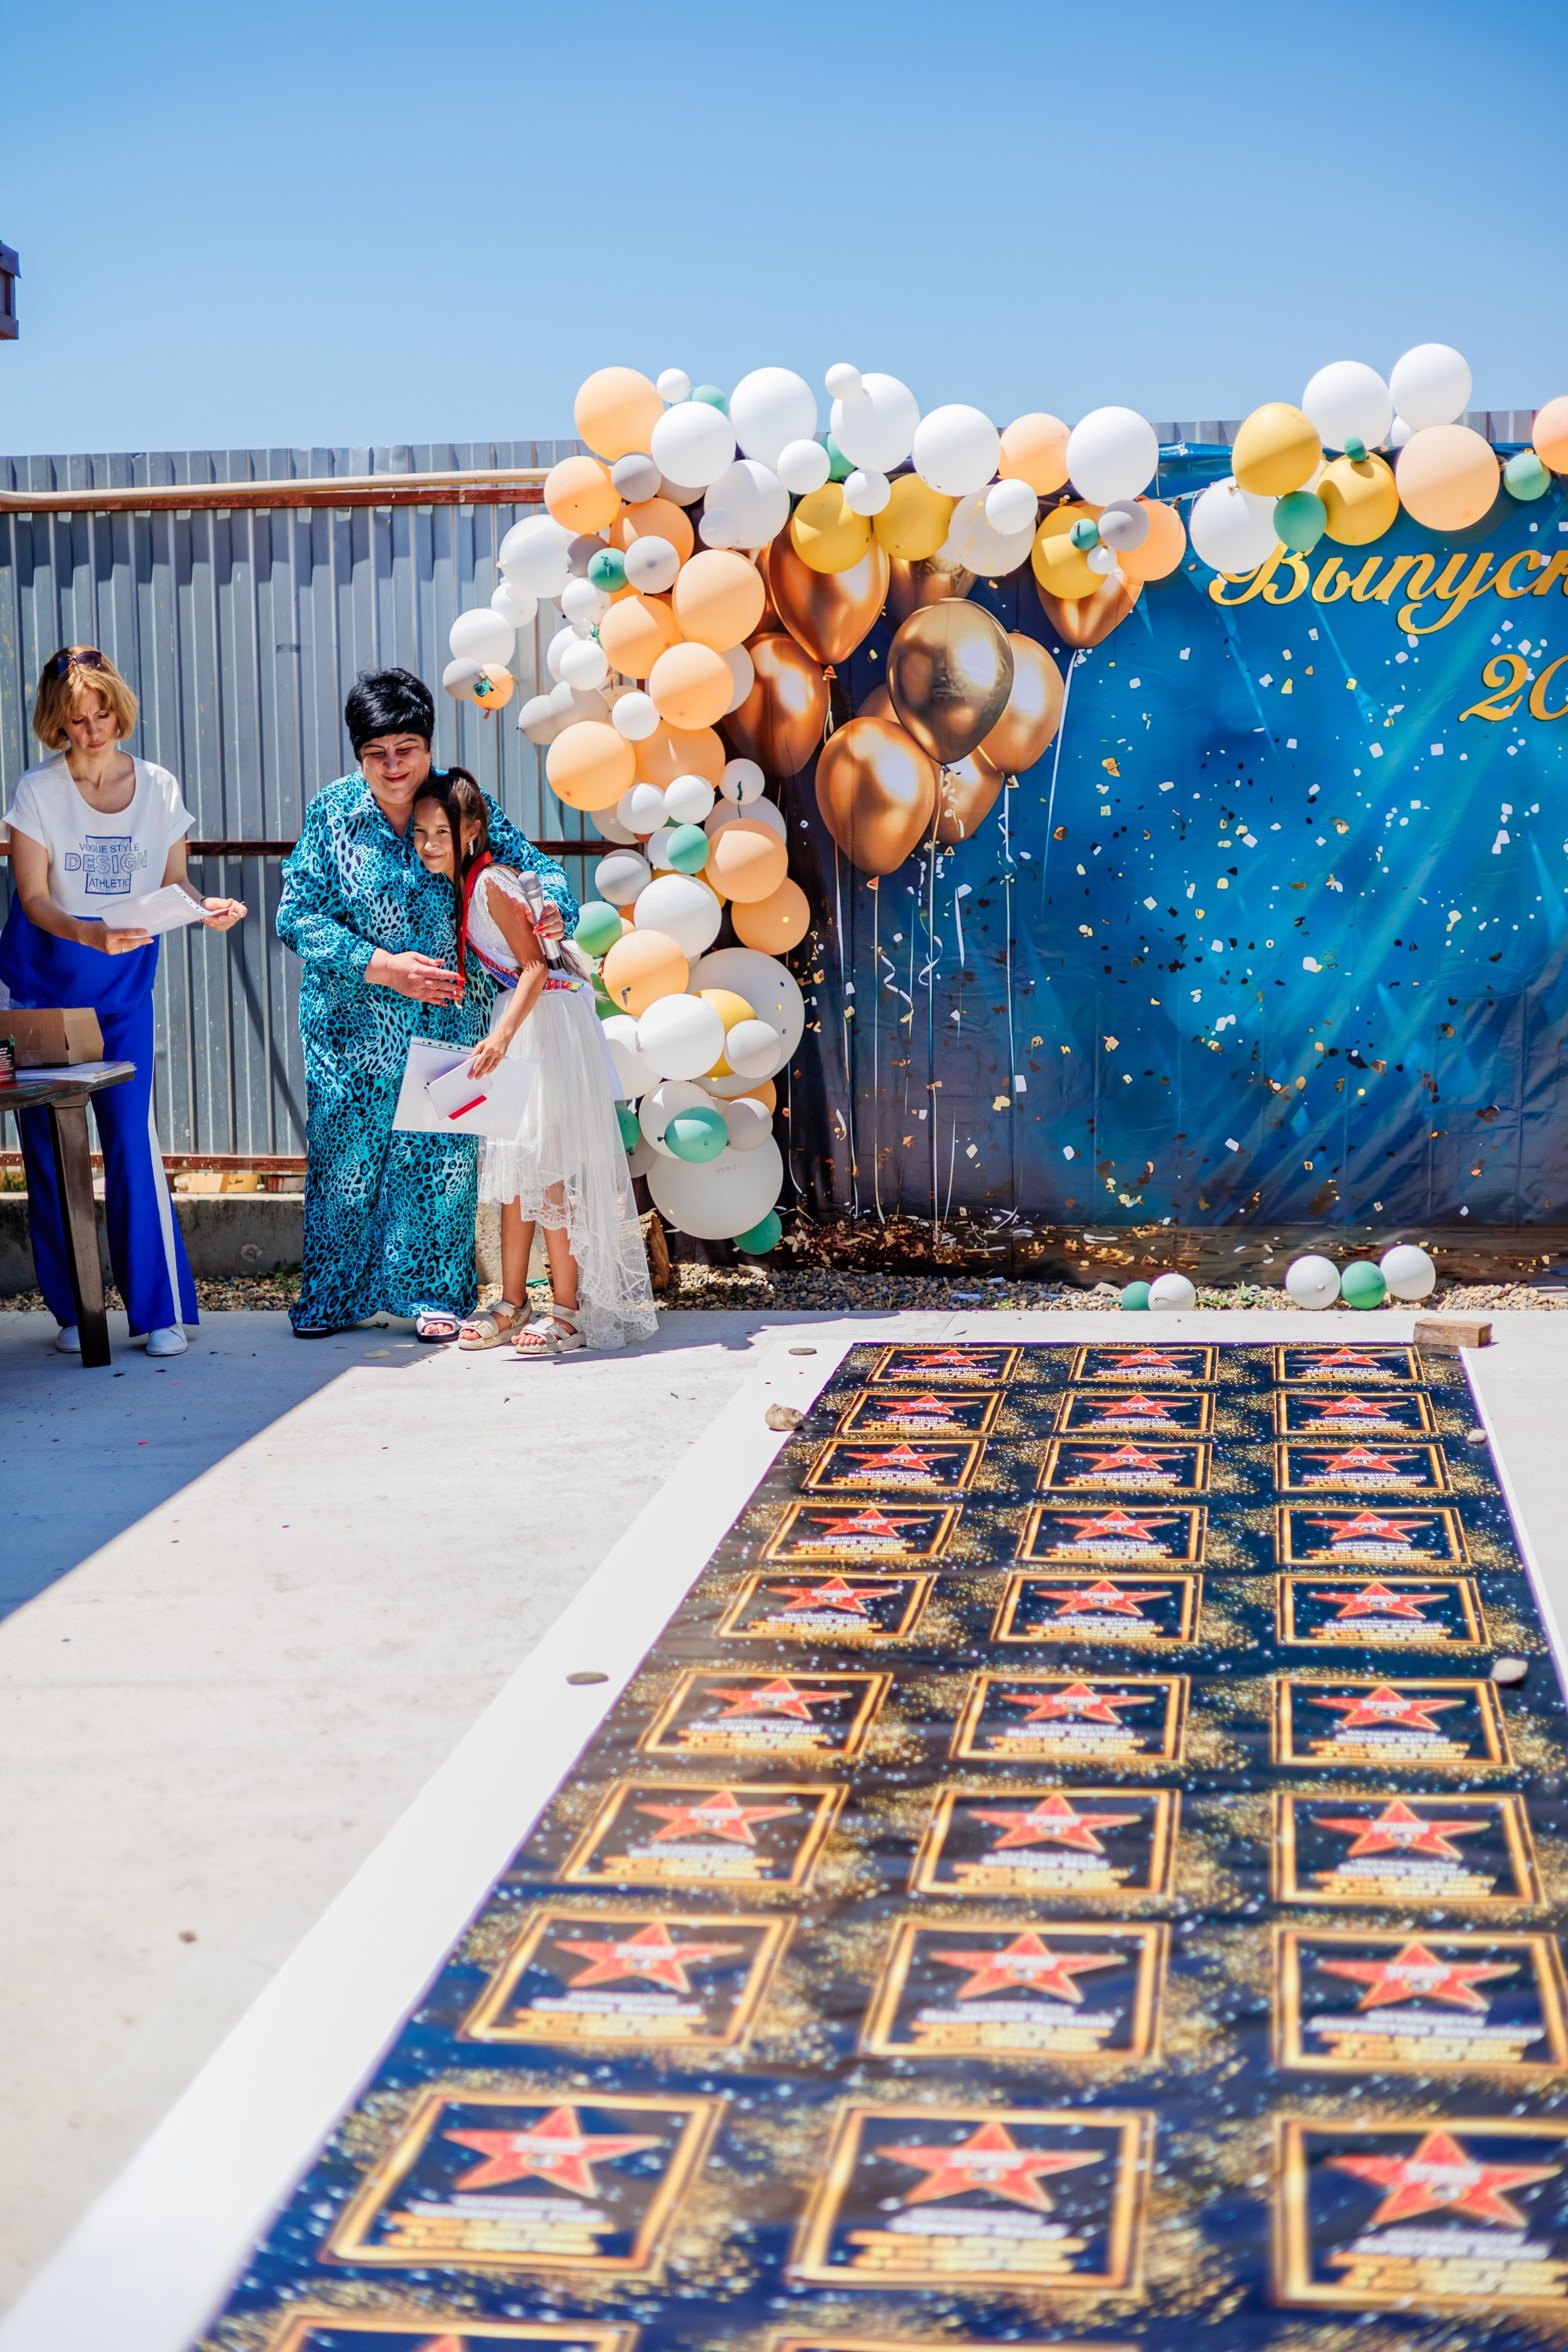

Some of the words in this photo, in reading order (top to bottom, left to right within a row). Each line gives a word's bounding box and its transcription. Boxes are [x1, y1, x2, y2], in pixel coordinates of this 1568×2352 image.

[79, 843, 107, 853] VOGUE
[110, 843, 140, 854] STYLE
[64, 849, 147, 874] DESIGN
[89, 878, 131, 888] ATHLETIC
